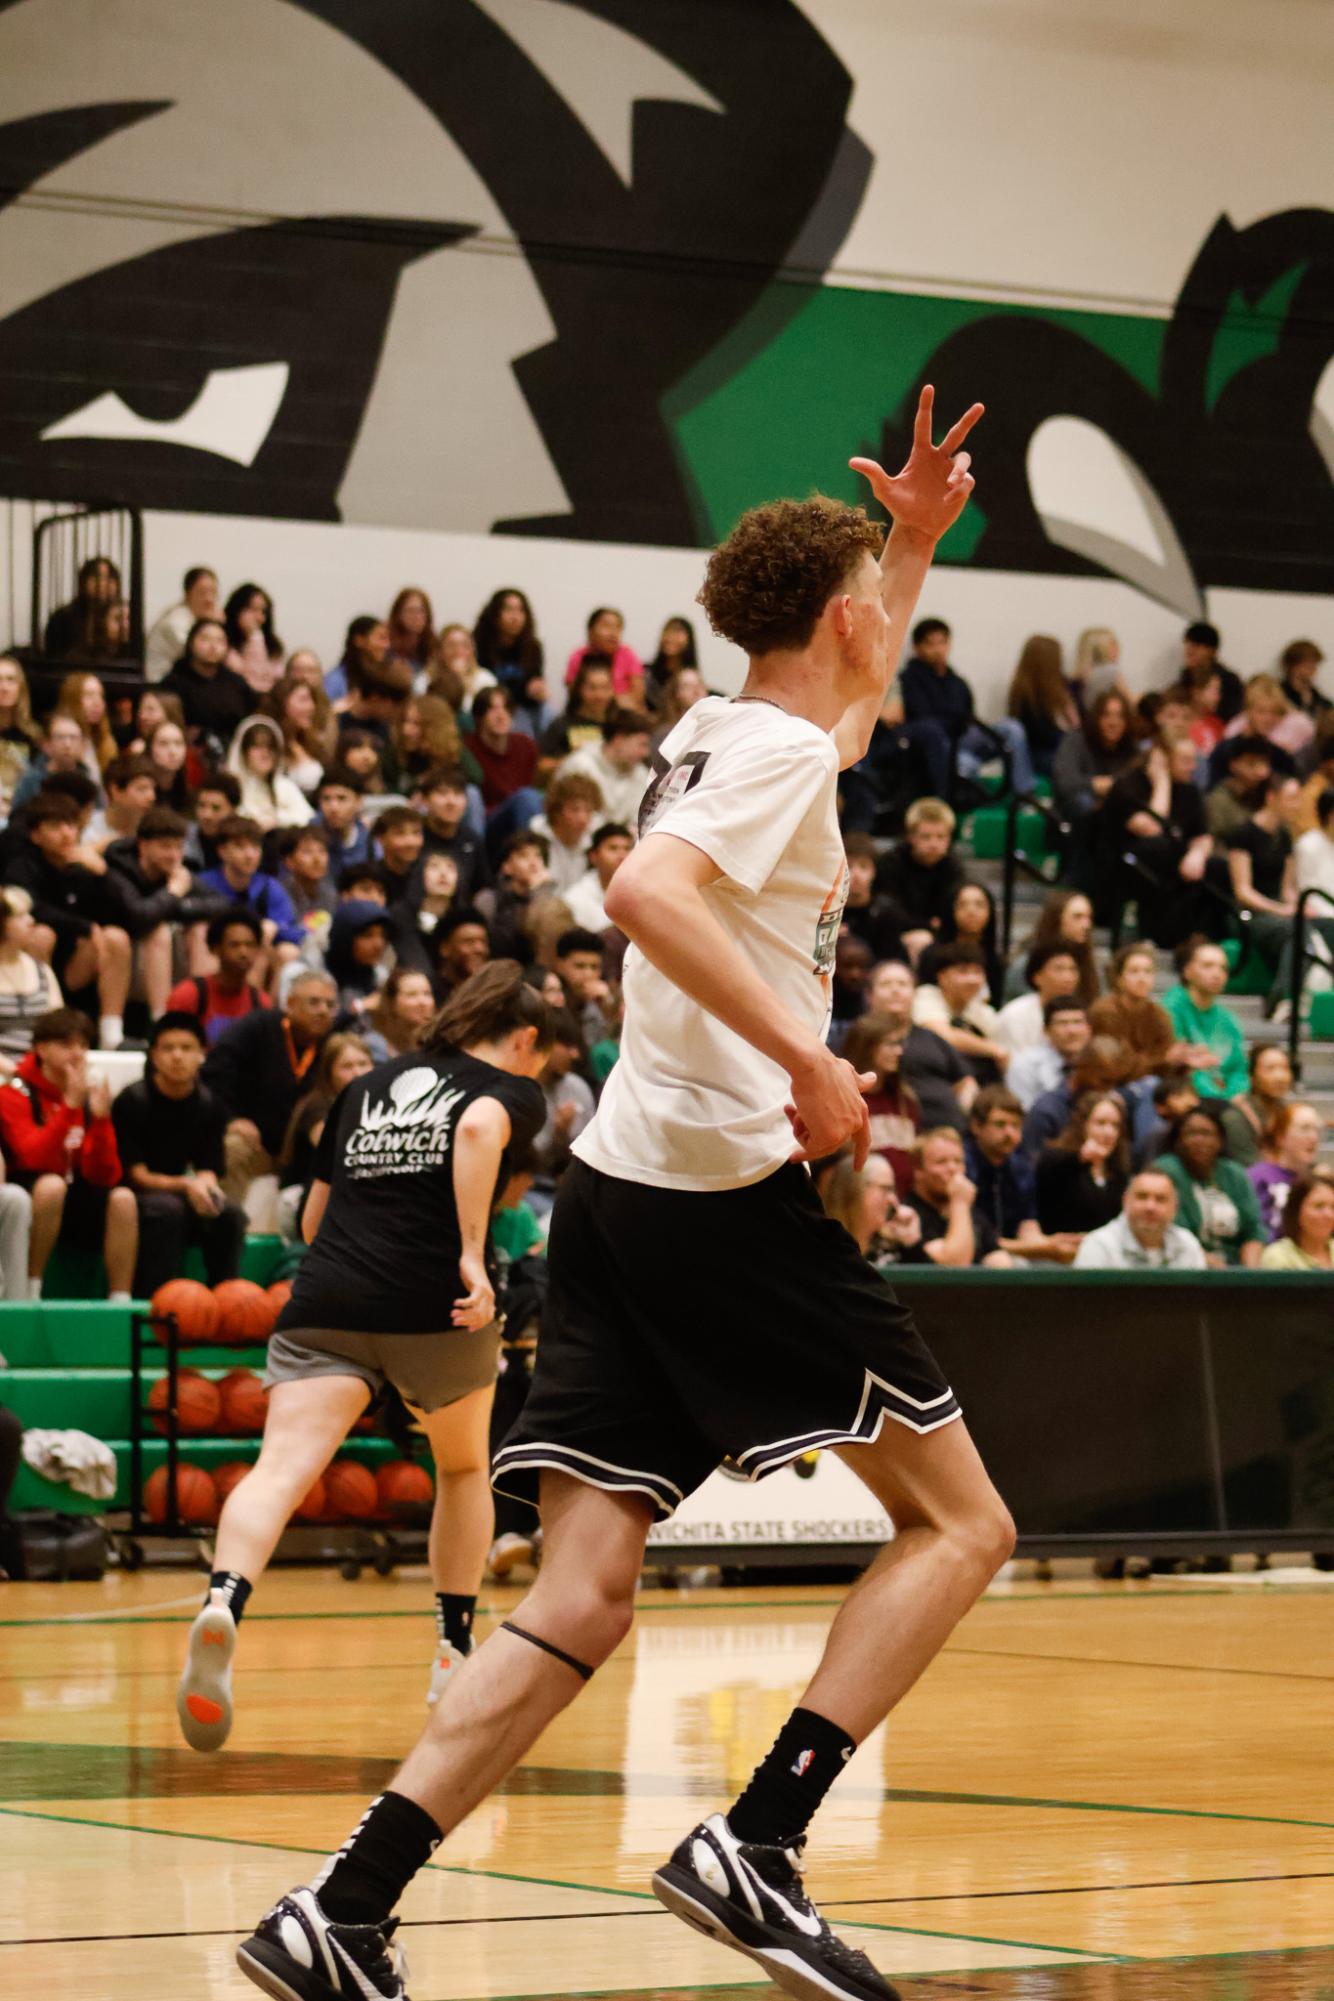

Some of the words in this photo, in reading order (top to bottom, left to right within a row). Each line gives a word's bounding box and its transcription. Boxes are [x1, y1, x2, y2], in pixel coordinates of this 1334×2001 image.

[346, 1124, 449, 1154] Colwich
[408, 1153, 444, 1164] CLUB
[732, 1521, 786, 1538] STATE
[793, 1520, 888, 1538] SHOCKERS
